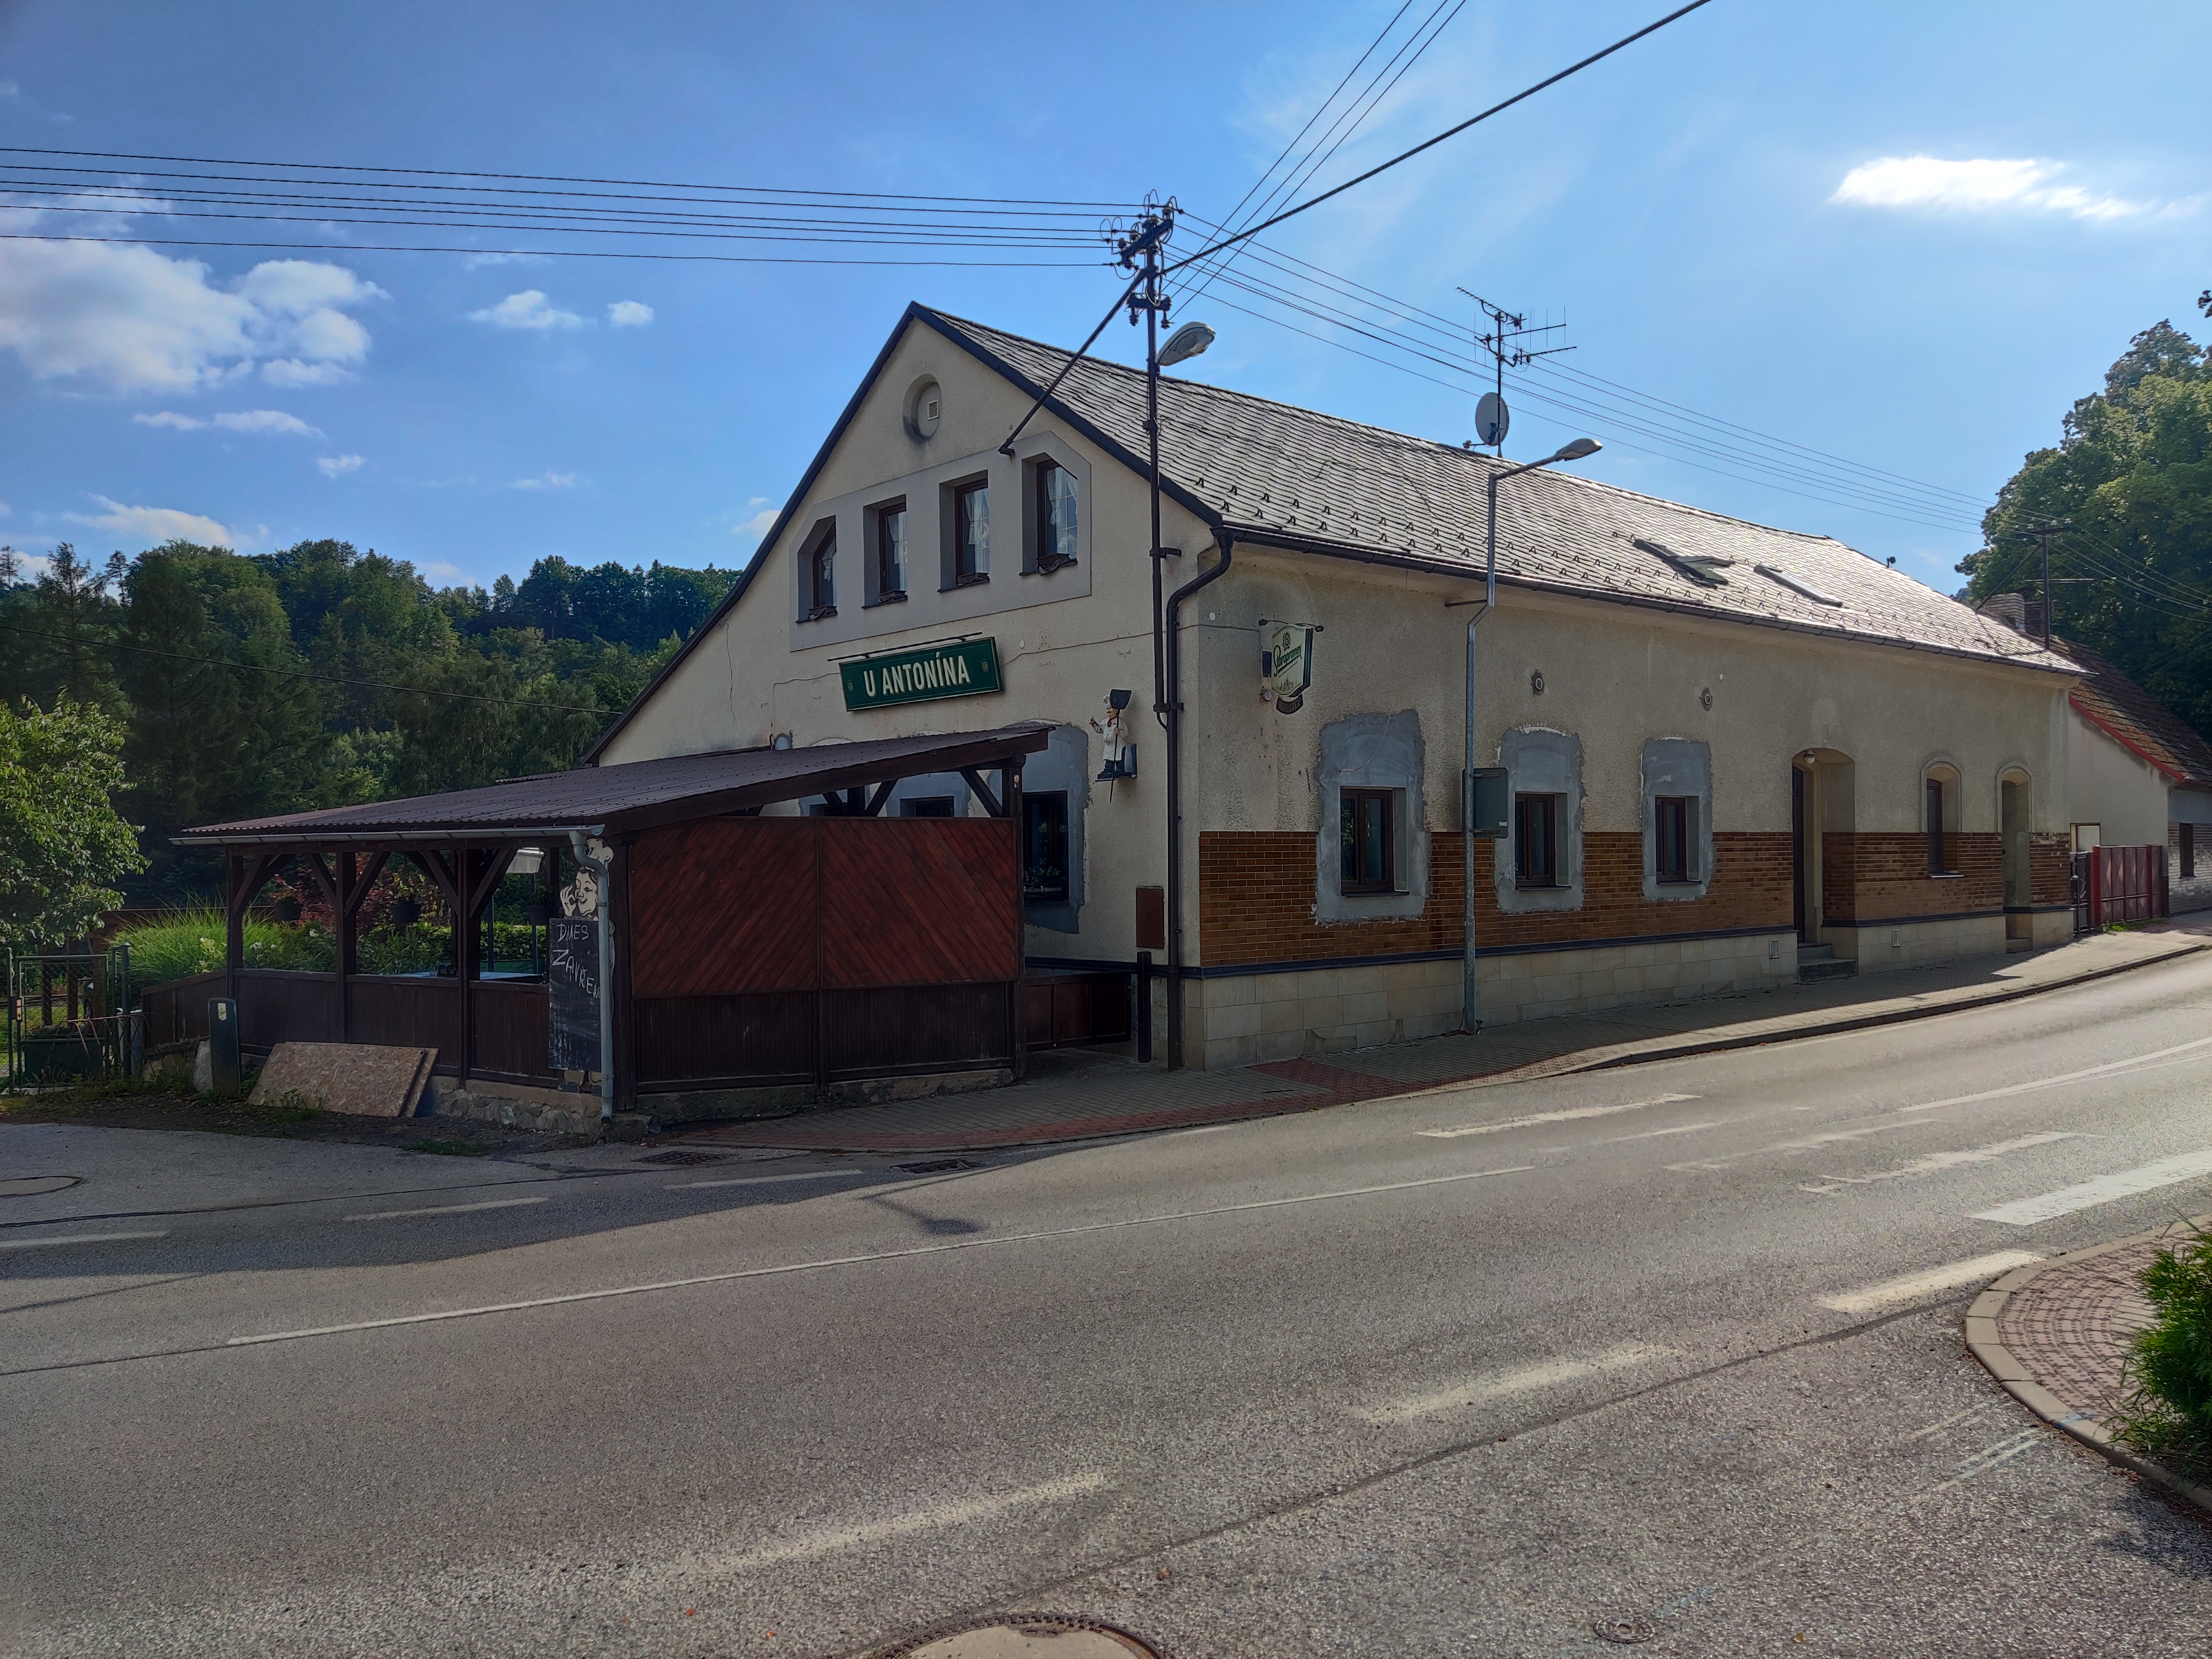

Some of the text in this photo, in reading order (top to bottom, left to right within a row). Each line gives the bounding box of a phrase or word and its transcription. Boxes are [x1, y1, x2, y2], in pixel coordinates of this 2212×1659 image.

[863, 652, 971, 697] U ANTONÍNA
[1274, 645, 1302, 676] Staropramen
[555, 922, 589, 943] DNES
